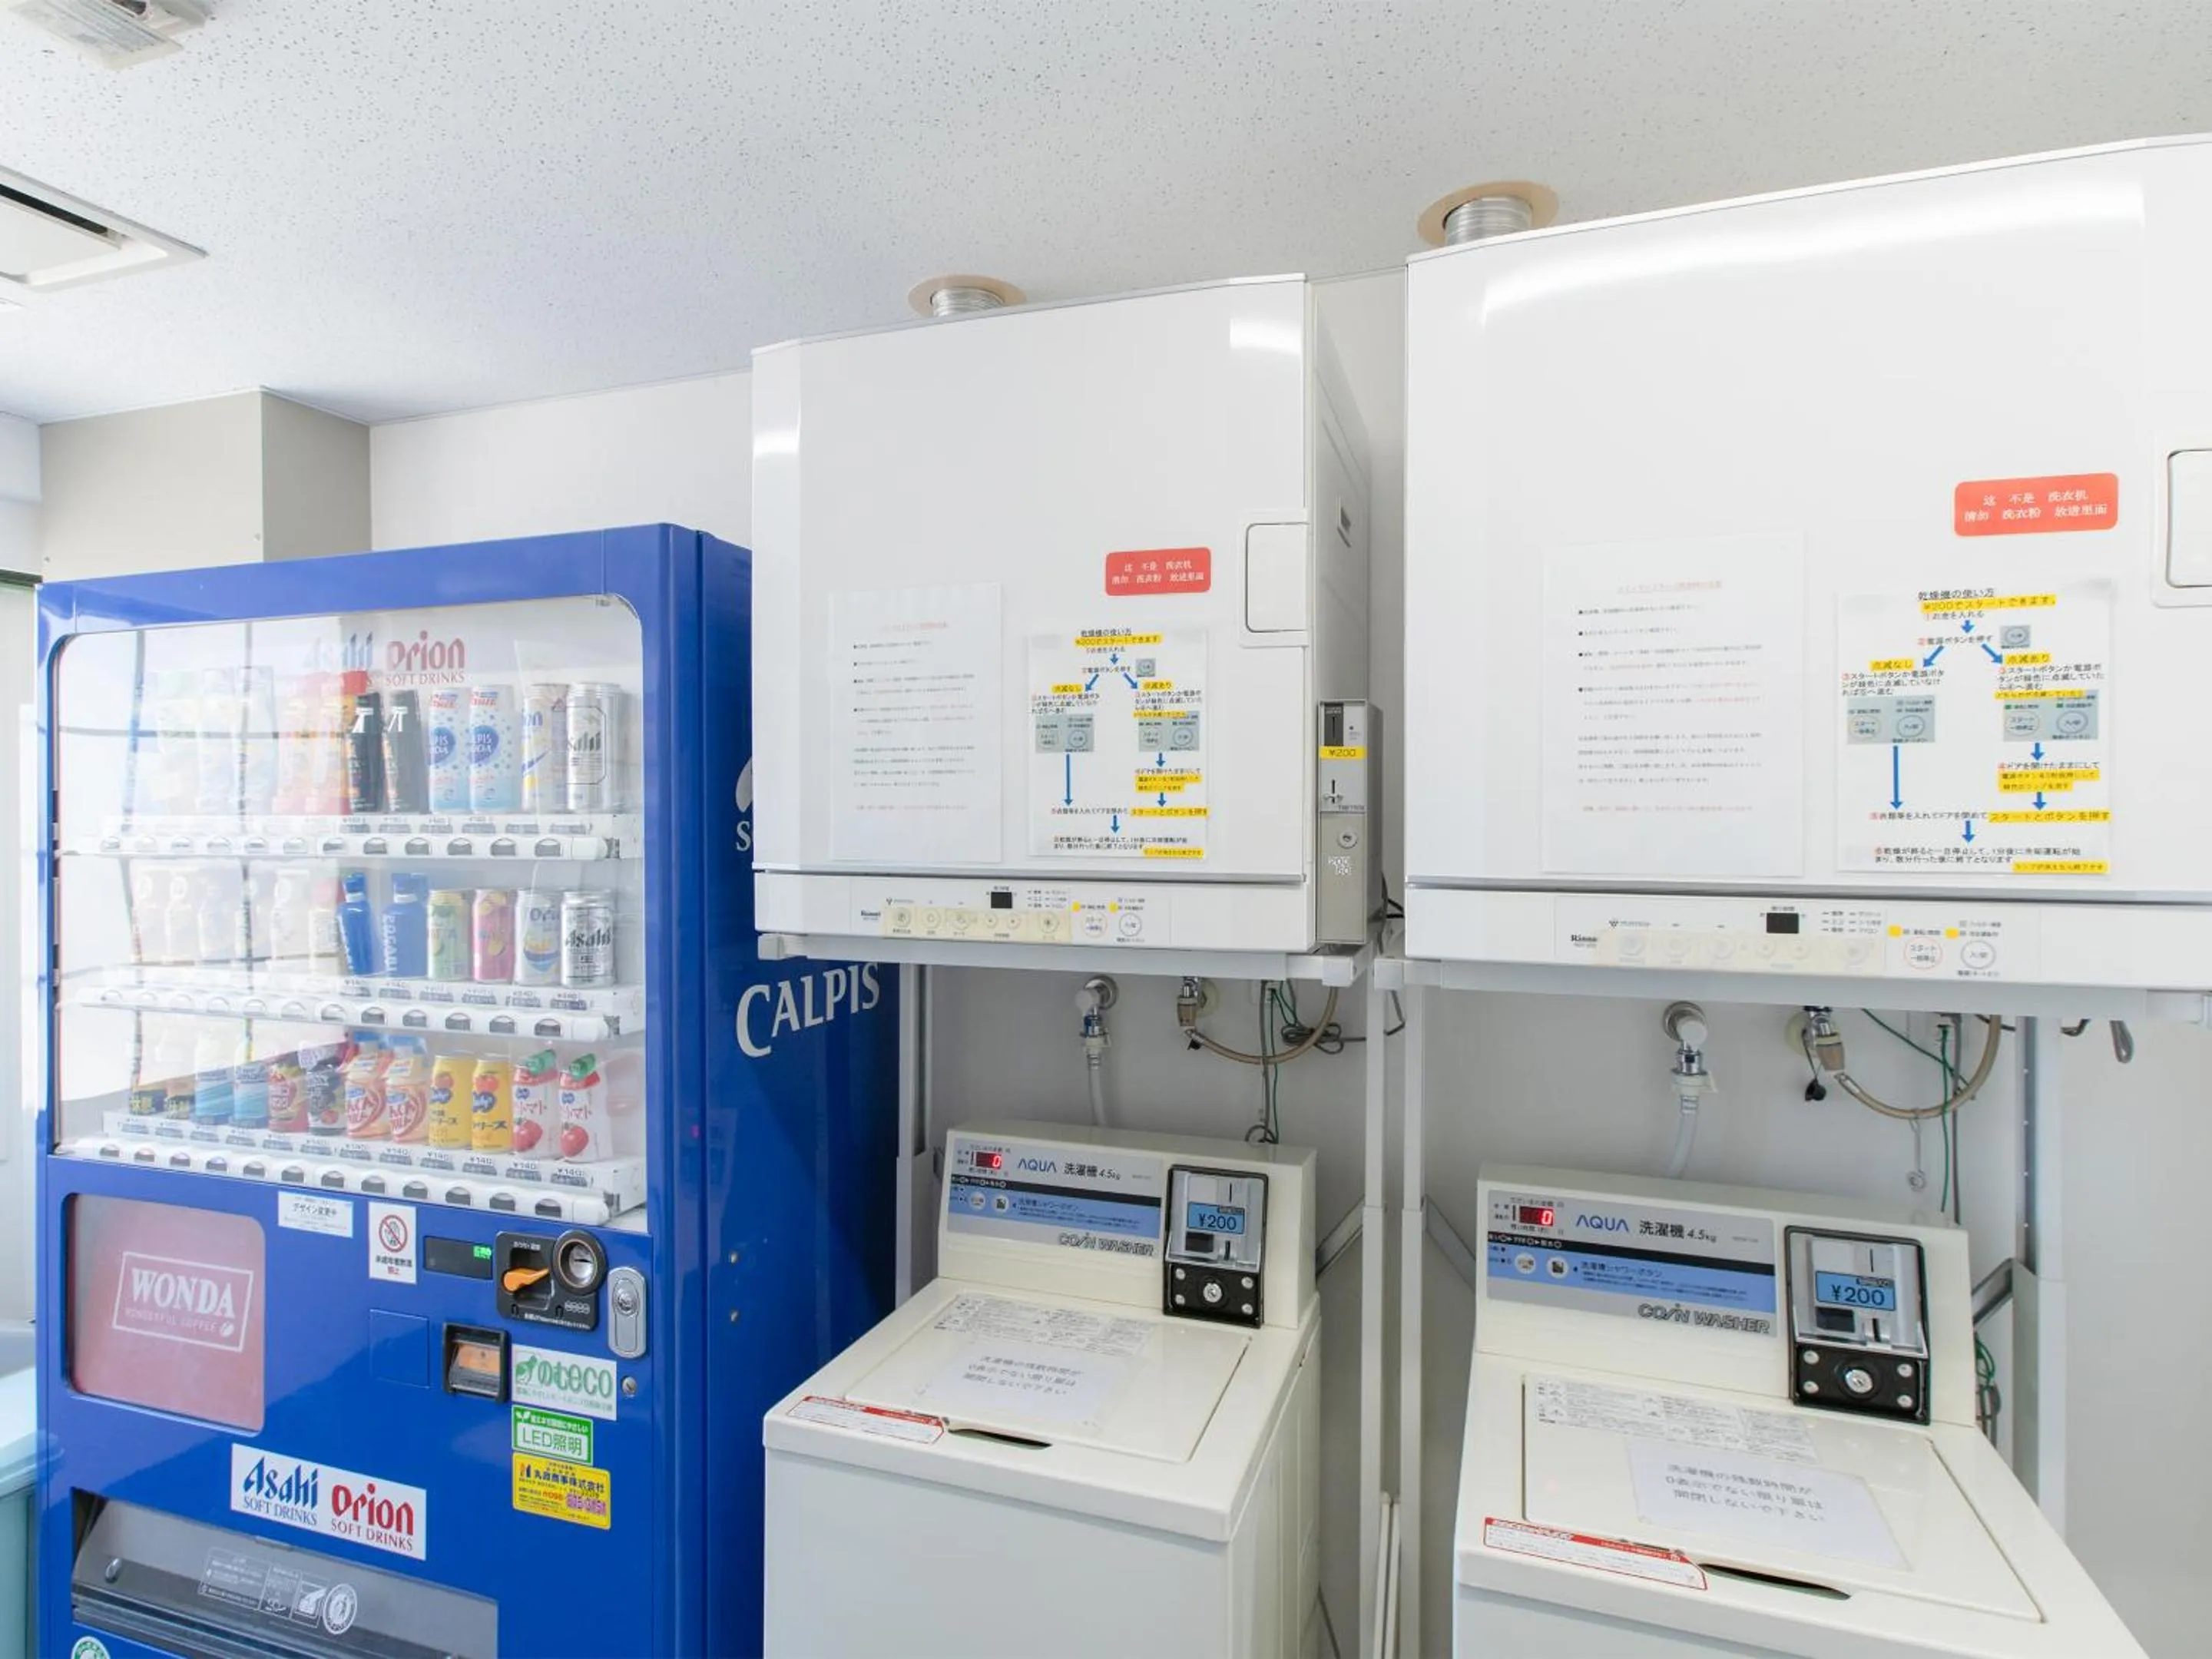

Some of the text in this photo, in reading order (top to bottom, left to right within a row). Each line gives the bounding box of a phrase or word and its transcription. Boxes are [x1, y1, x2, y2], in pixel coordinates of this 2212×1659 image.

[736, 962, 880, 1058] CALPIS
[992, 1155, 1002, 1167] 0
[1017, 1157, 1058, 1174] AQUA
[1064, 1162, 1098, 1178] 洗濯機
[1198, 1212, 1237, 1230] ¥200
[1541, 1210, 1553, 1224] 0
[1576, 1214, 1717, 1244] AQUA 洗濯機 4.5kg
[131, 1267, 236, 1319] WONDA
[1830, 1283, 1885, 1306] ¥200
[1637, 1303, 1770, 1334] COIN WASHER
[522, 1426, 582, 1456] LED照明
[243, 1455, 414, 1536] Asahi Orion
[243, 1496, 318, 1526] SOFT DRINKS
[330, 1518, 413, 1551] SOFT DRINKS
